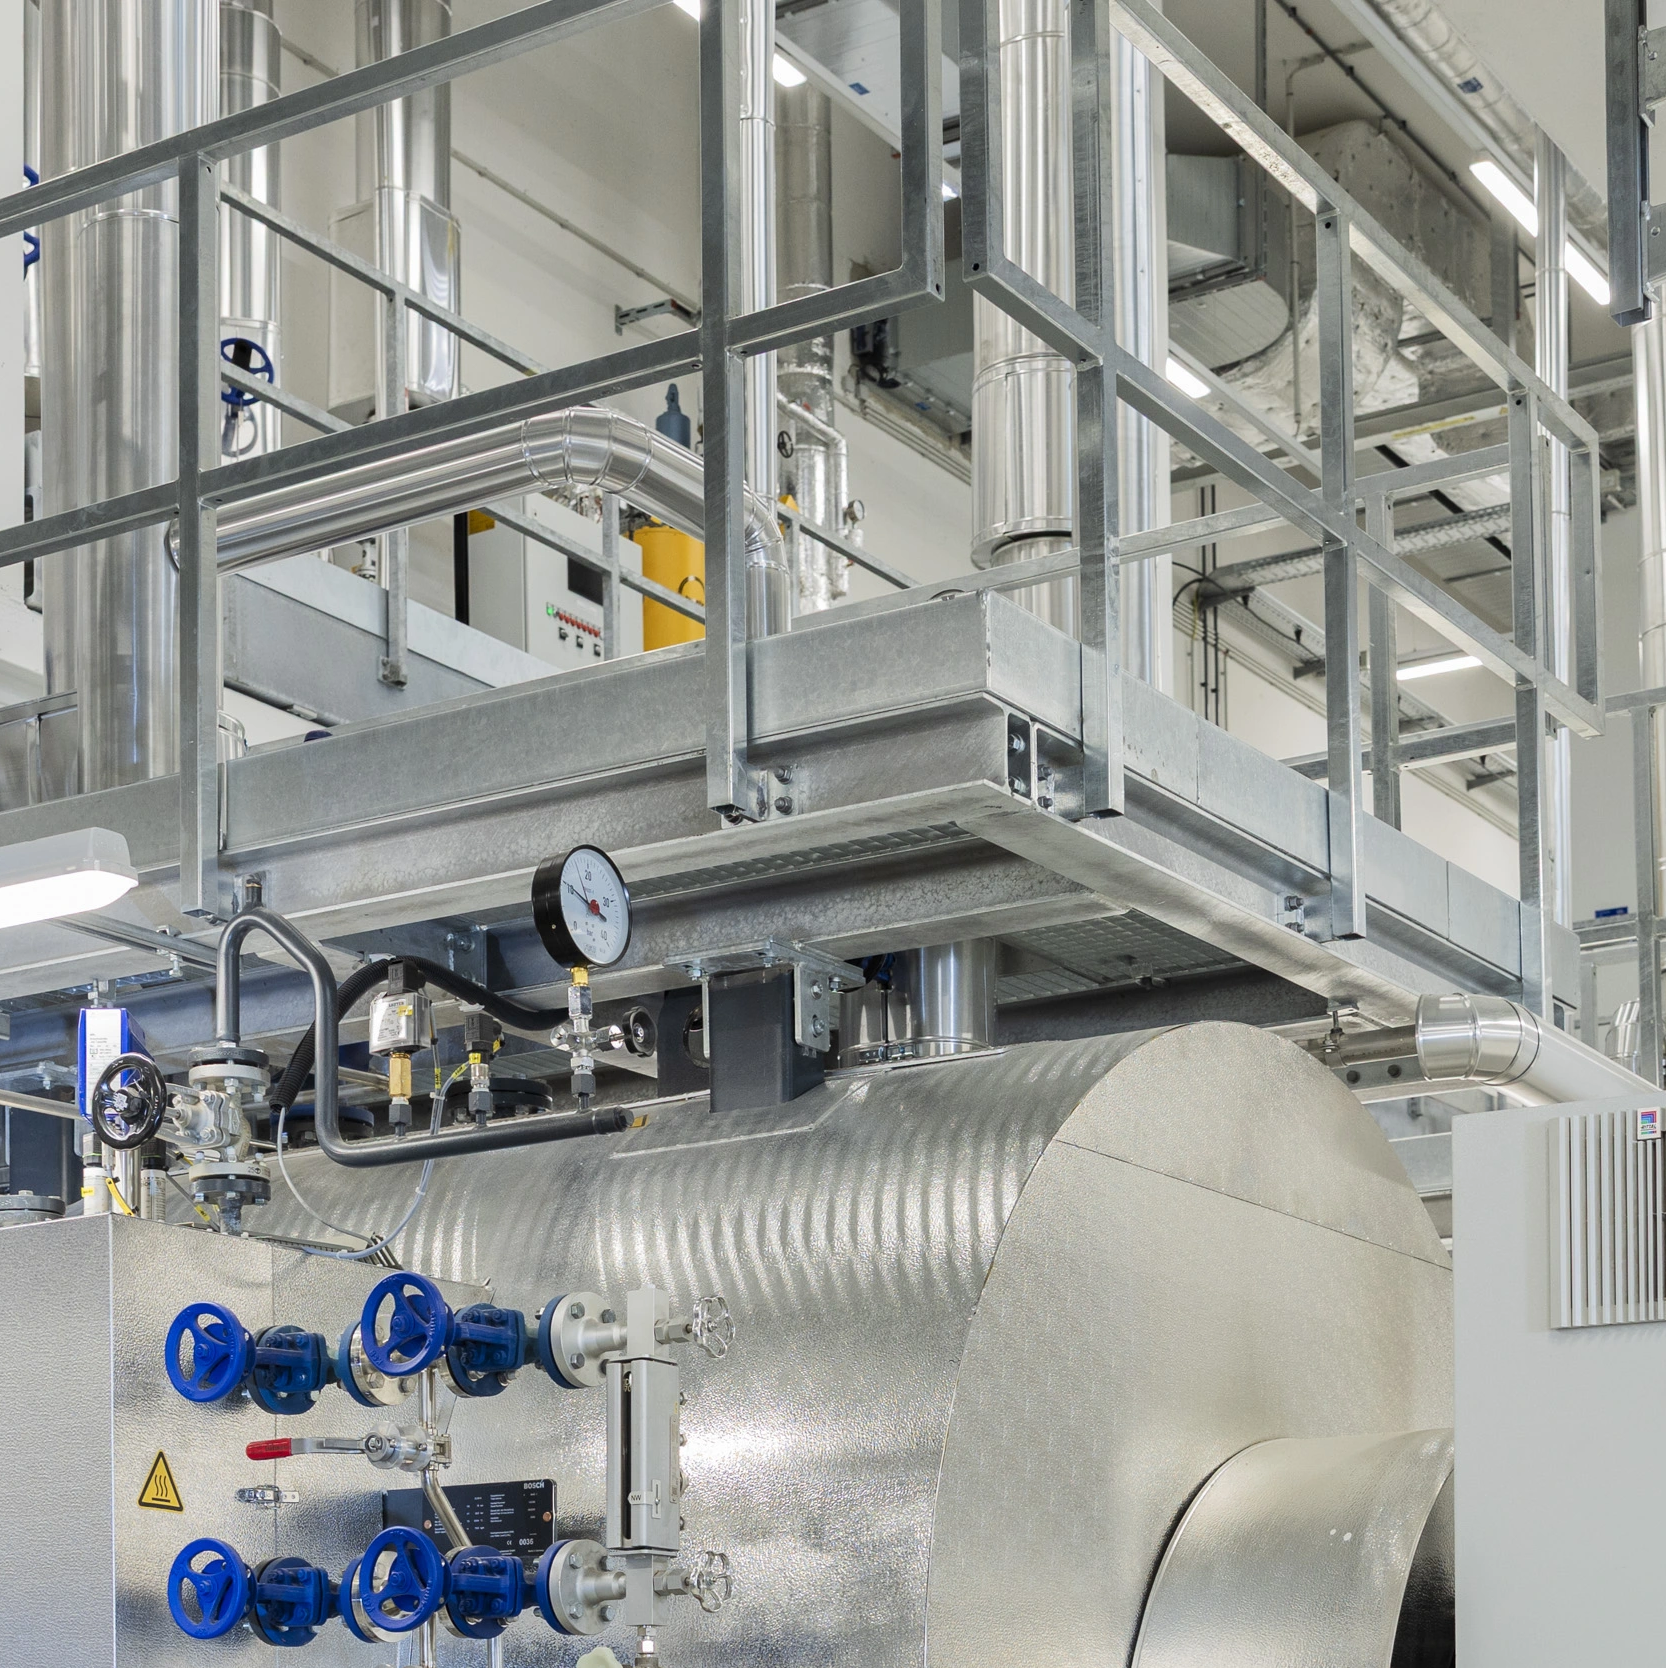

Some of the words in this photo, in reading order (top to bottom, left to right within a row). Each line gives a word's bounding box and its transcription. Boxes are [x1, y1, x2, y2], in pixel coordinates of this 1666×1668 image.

[584, 869, 592, 881] 20
[602, 896, 610, 908] 30
[523, 1481, 545, 1490] BOSCH
[519, 1538, 534, 1546] 0036
